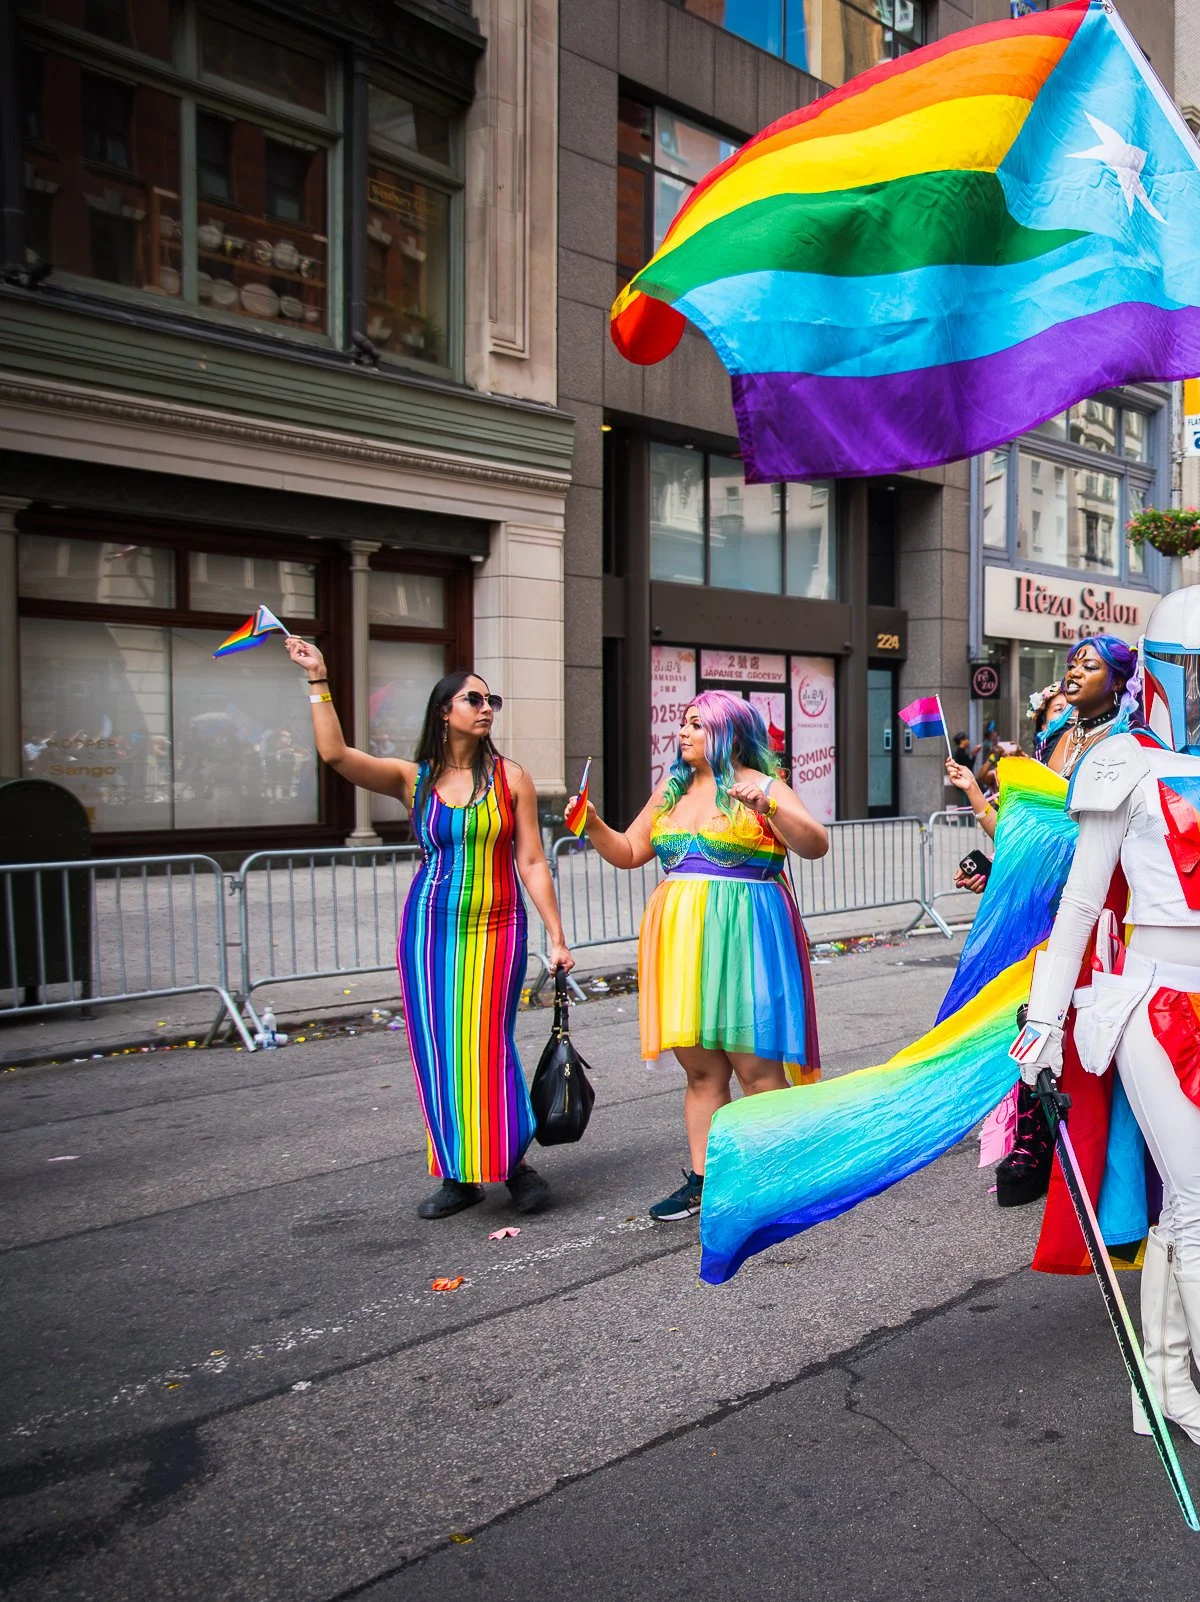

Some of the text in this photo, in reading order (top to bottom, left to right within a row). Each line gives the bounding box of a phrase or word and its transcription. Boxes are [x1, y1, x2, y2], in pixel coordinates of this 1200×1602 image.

[1079, 587, 1140, 626] Salon
[1055, 621, 1077, 640] For
[877, 633, 900, 650] 224
[703, 668, 783, 680] JAPANESE GROCERY
[791, 746, 836, 769] COMING
[799, 763, 832, 784] SOON
